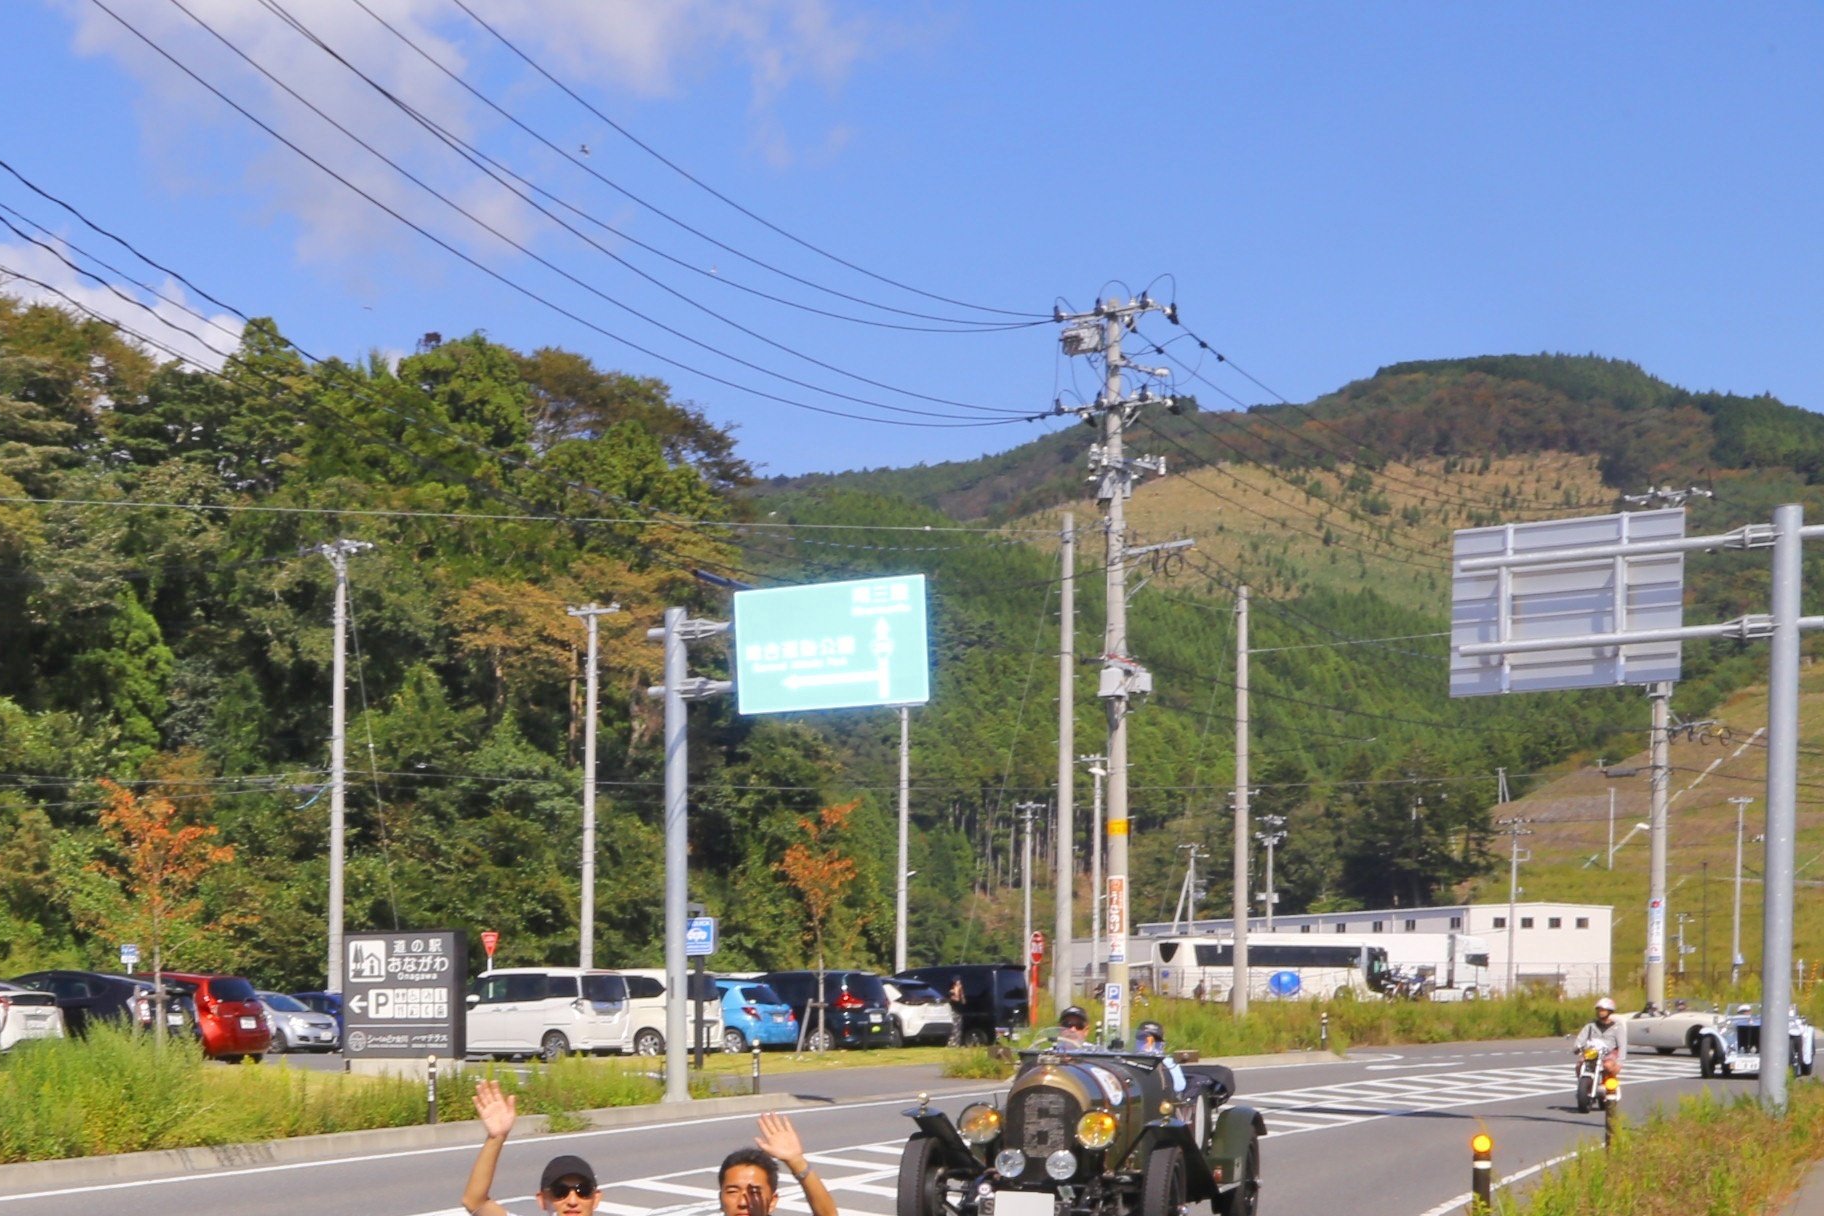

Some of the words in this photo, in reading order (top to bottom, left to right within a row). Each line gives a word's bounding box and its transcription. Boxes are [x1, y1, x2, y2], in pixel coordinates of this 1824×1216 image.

[392, 938, 443, 953] 道の駅
[387, 955, 449, 973] おながわ
[397, 972, 438, 981] Onagawa
[1109, 987, 1118, 998] P
[376, 993, 388, 1014] P
